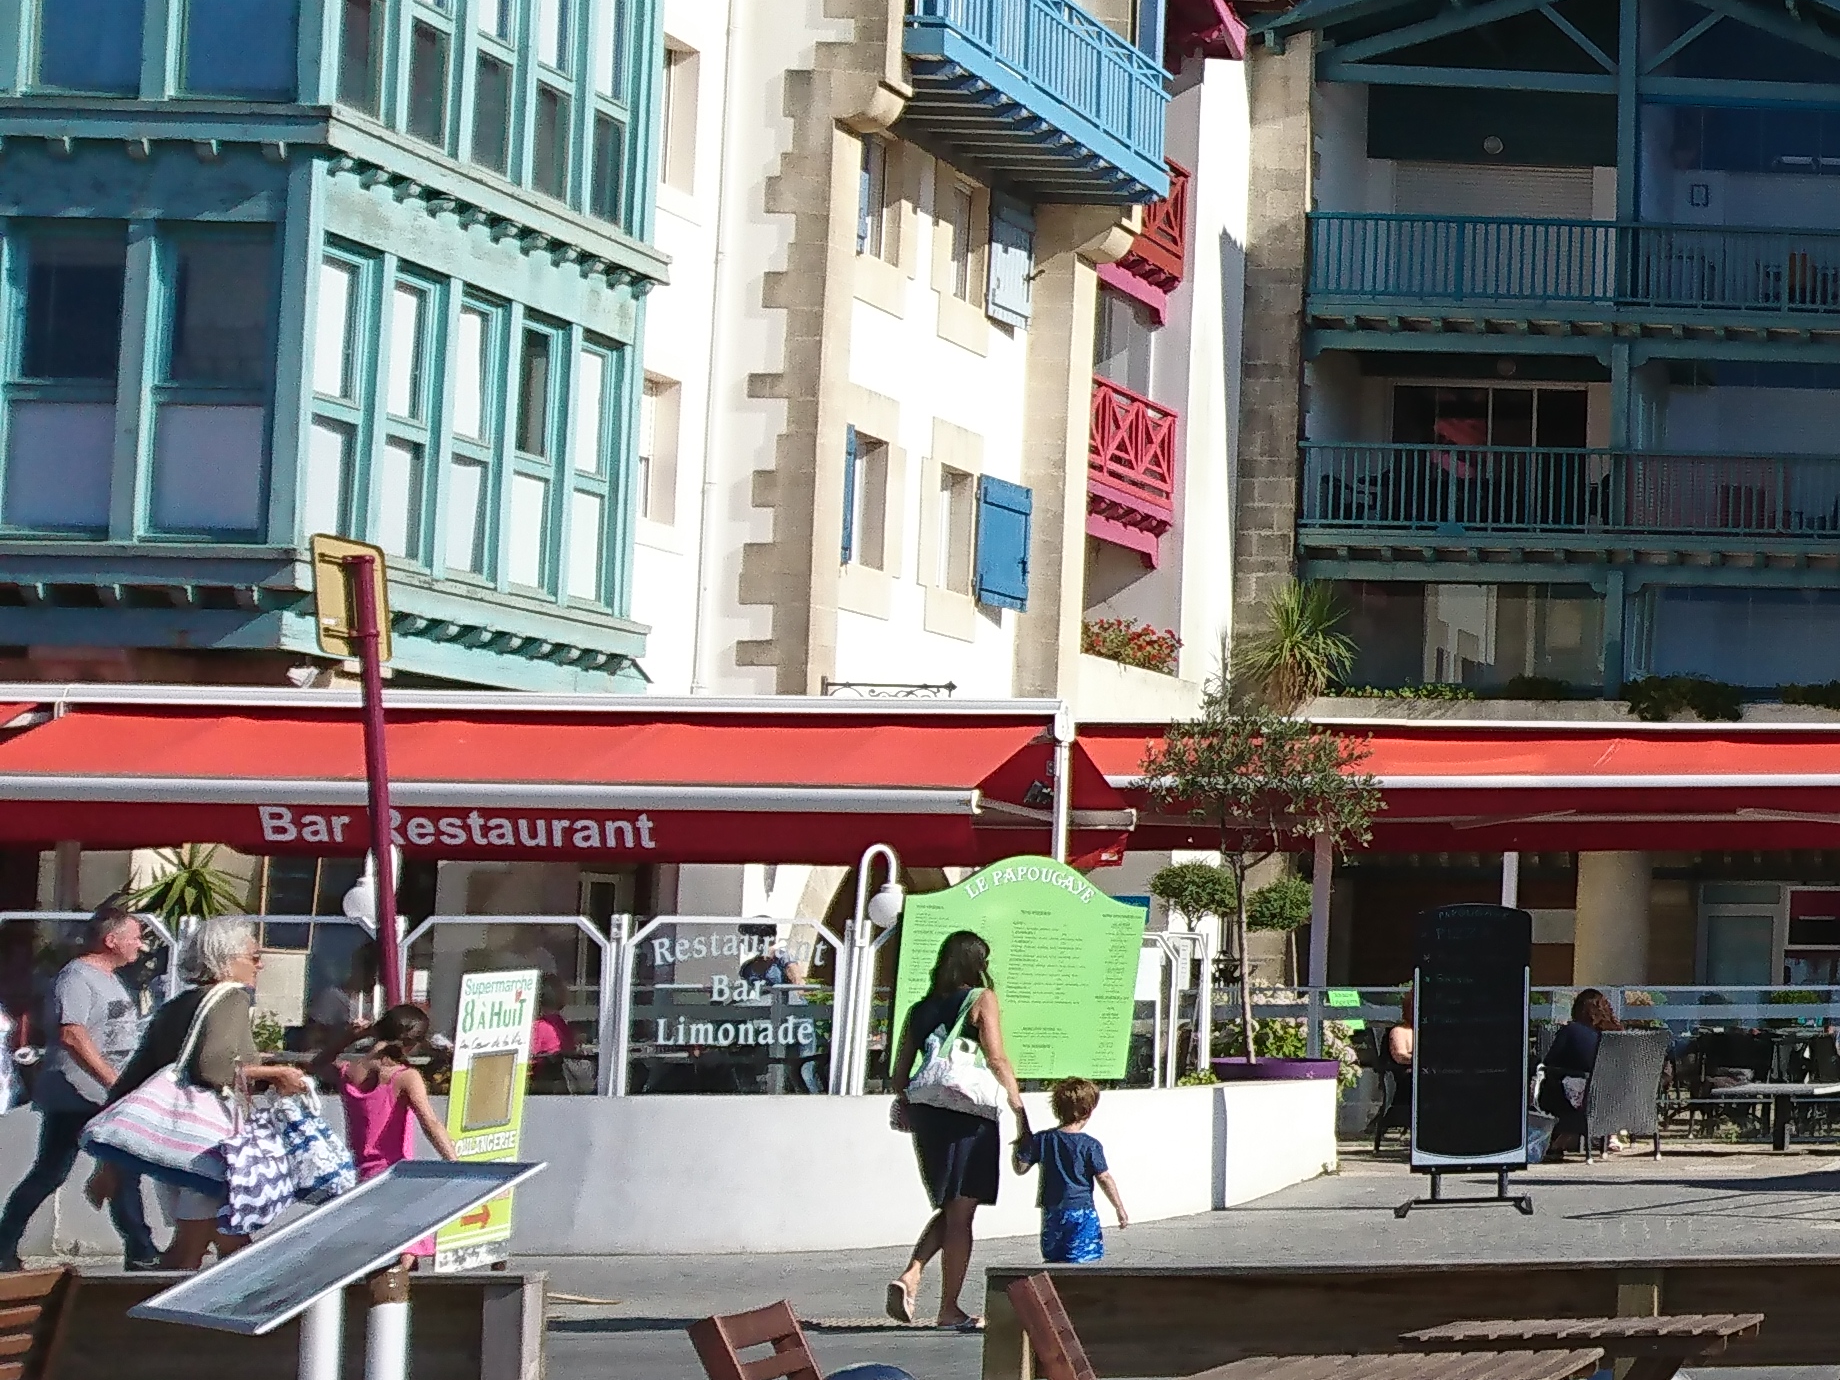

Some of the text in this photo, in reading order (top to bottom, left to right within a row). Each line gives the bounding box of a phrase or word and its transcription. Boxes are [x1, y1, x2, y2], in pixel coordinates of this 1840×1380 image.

[257, 805, 350, 844] Bar
[963, 866, 1096, 904] LE PAPOUGAYE
[651, 931, 828, 966] Restaurant
[710, 974, 767, 1002] Bar
[462, 998, 476, 1034] 8
[656, 1014, 814, 1047] Limonade
[452, 1129, 517, 1158] OULANGERIE
